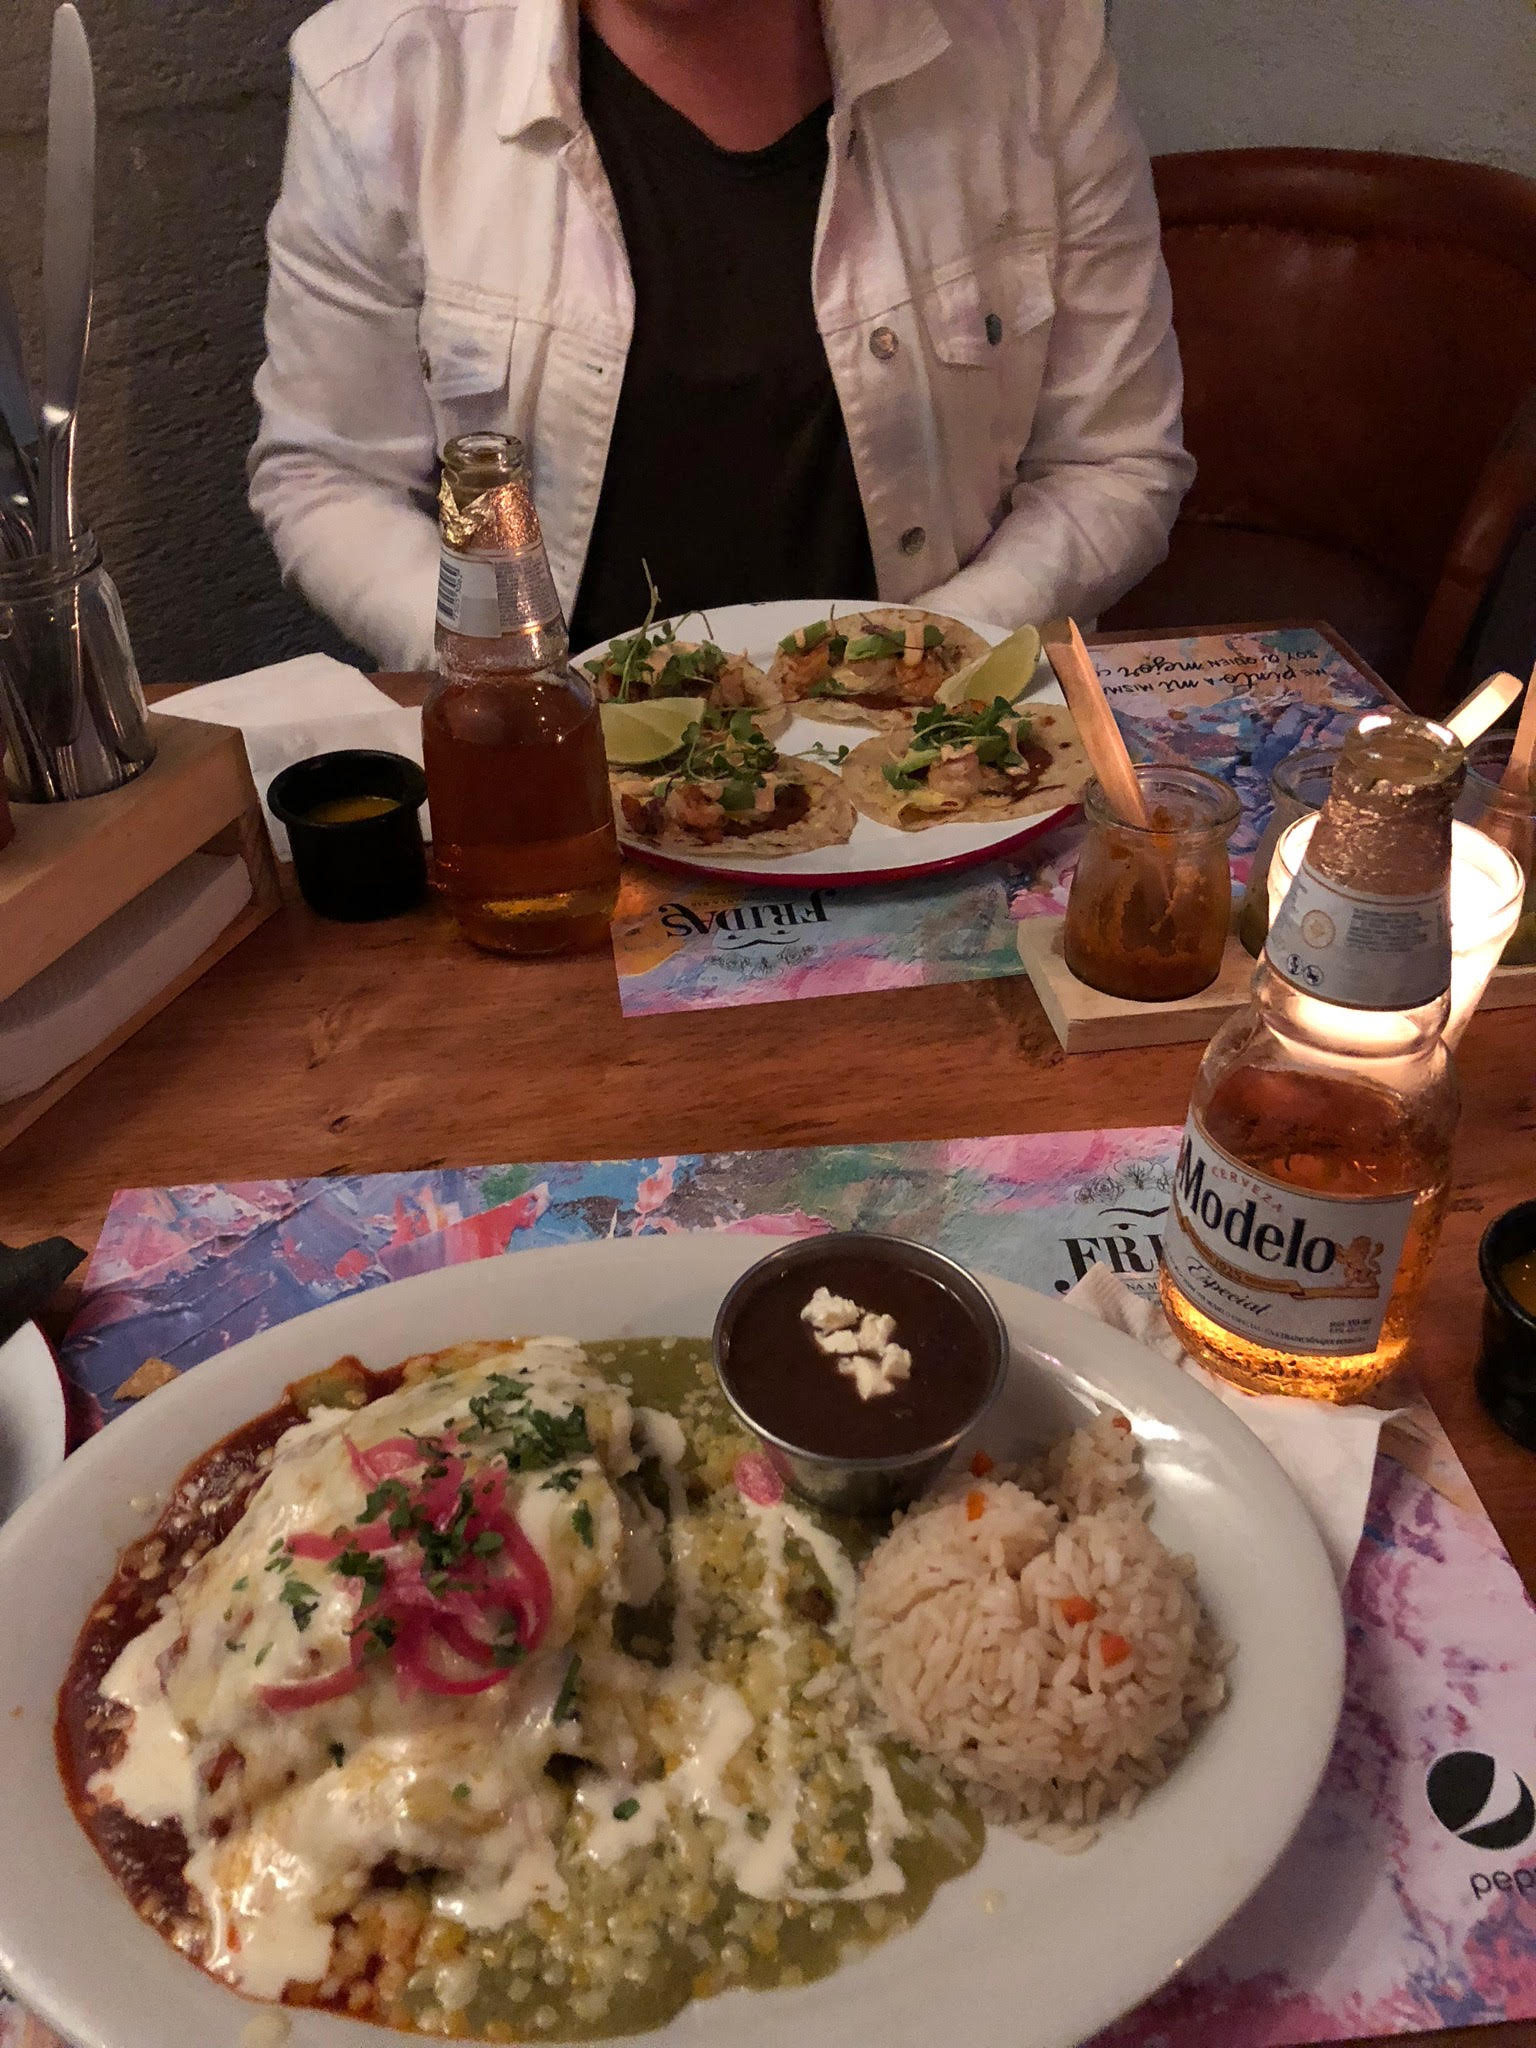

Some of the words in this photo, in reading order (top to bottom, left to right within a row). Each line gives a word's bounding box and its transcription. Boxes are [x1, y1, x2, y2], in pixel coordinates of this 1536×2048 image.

[1117, 656, 1203, 679] mejor
[1206, 656, 1258, 669] QUIEN
[1218, 664, 1297, 690] pinto
[657, 888, 838, 939] FRIDAS
[1175, 1133, 1336, 1275] Modelo
[1211, 1165, 1283, 1213] CERVEZA
[1054, 1233, 1164, 1296] FRI
[1186, 1255, 1274, 1317] Especial
[1469, 1867, 1536, 1901] pep
